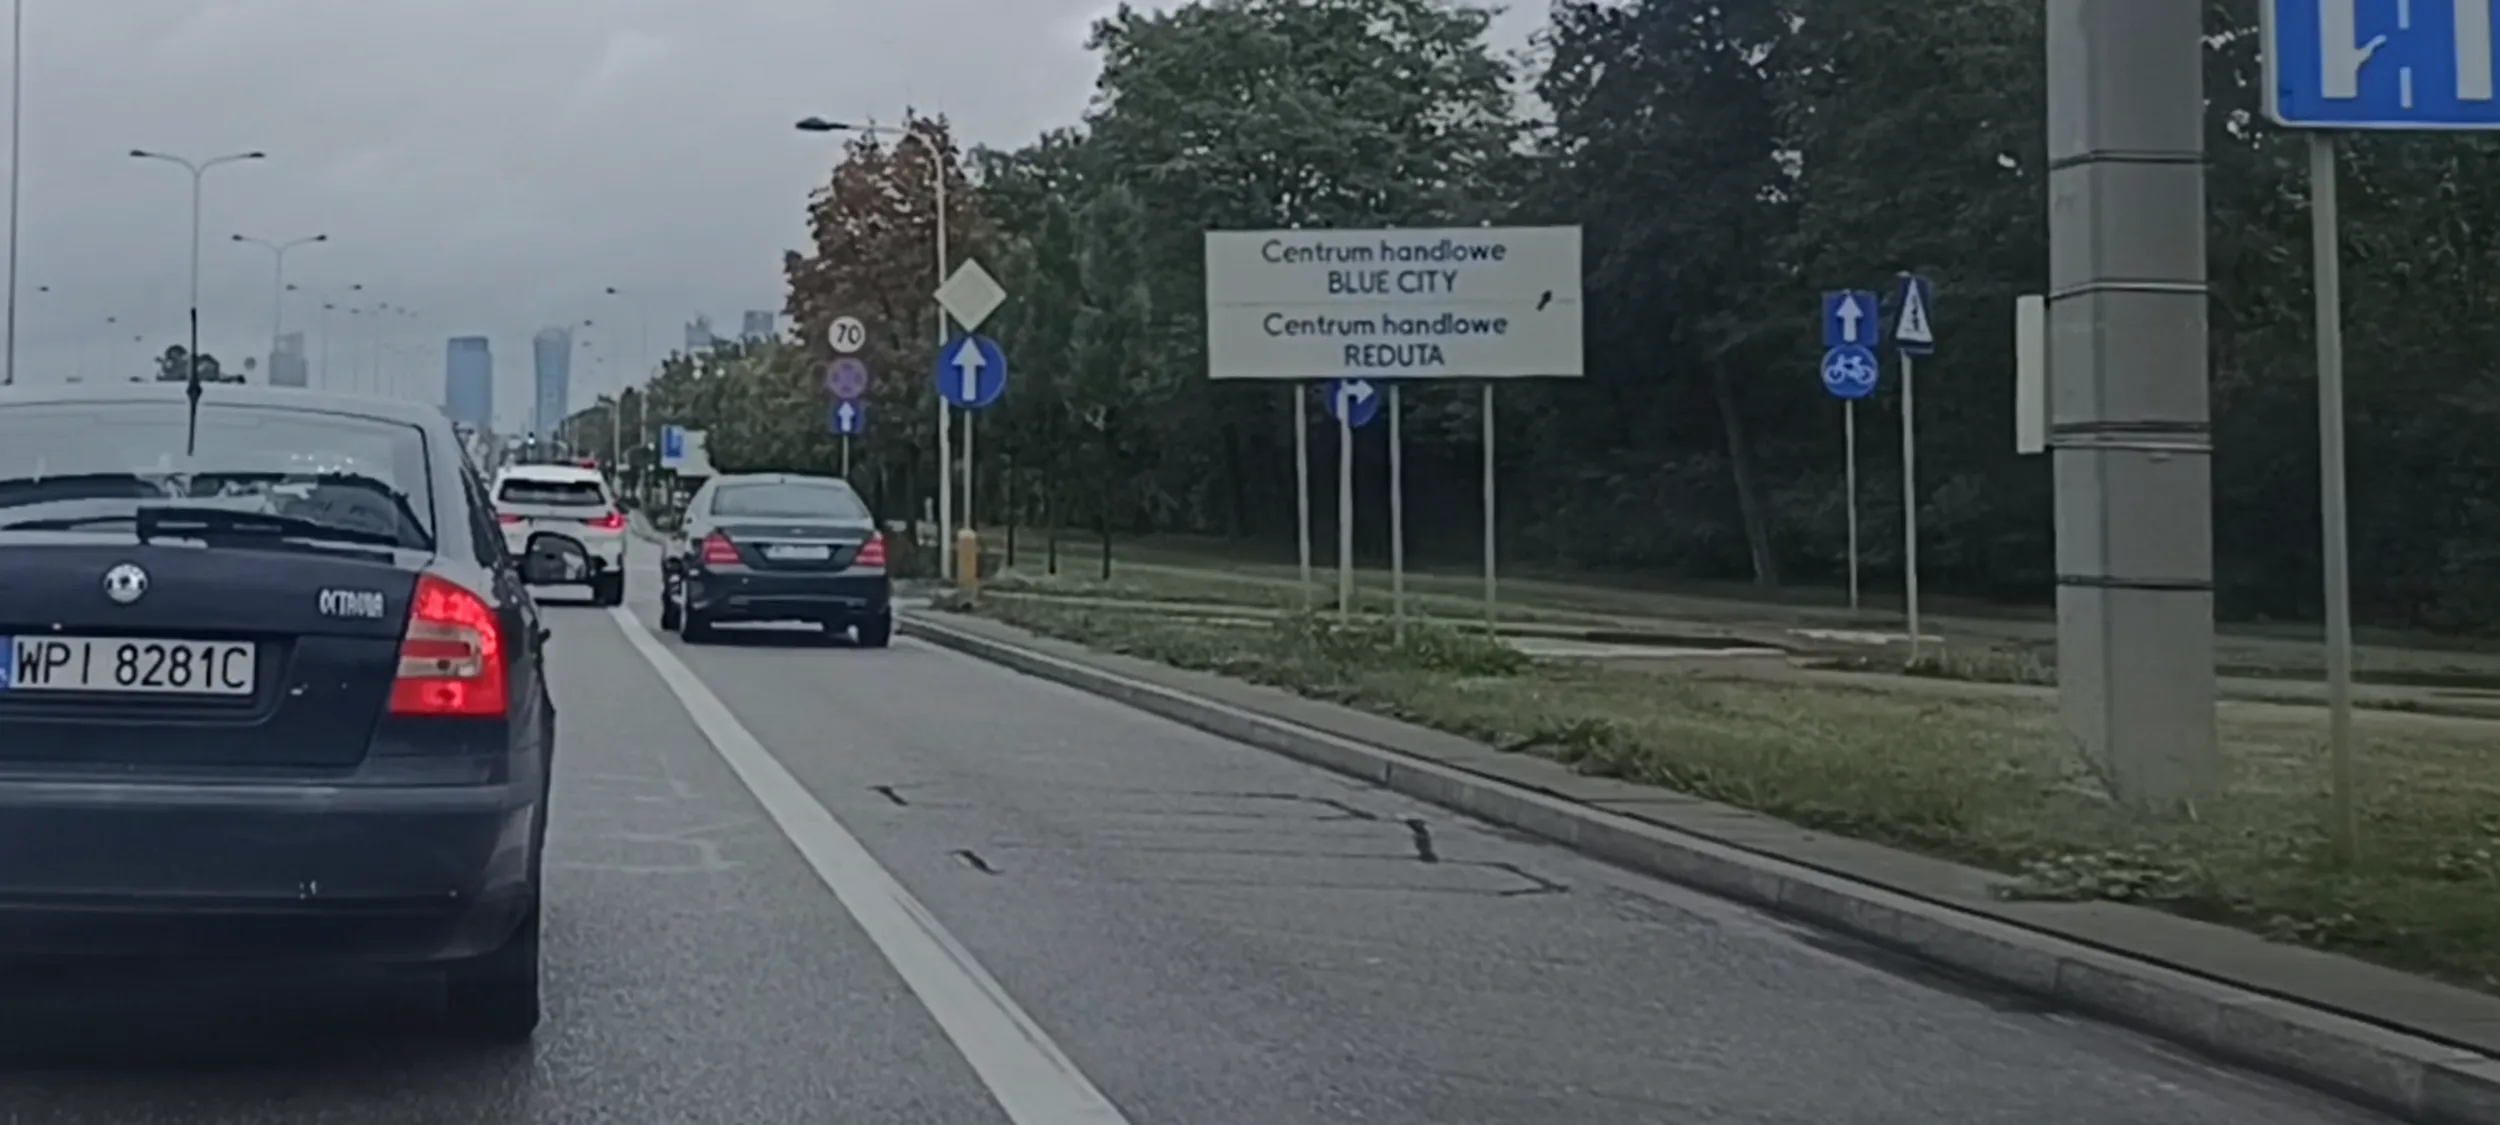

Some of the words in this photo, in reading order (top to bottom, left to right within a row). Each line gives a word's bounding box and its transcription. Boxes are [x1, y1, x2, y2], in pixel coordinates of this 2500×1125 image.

[1261, 239, 1373, 263] Centrum
[1381, 239, 1507, 262] handlowe
[1328, 270, 1389, 294] BLUE
[1397, 270, 1458, 294] CITY
[837, 324, 861, 345] 70
[1263, 312, 1376, 336] Centrum
[1383, 312, 1509, 335] handlowe
[1344, 343, 1445, 367] REDUTA
[18, 641, 91, 684] WPI
[115, 643, 248, 688] 8281C
